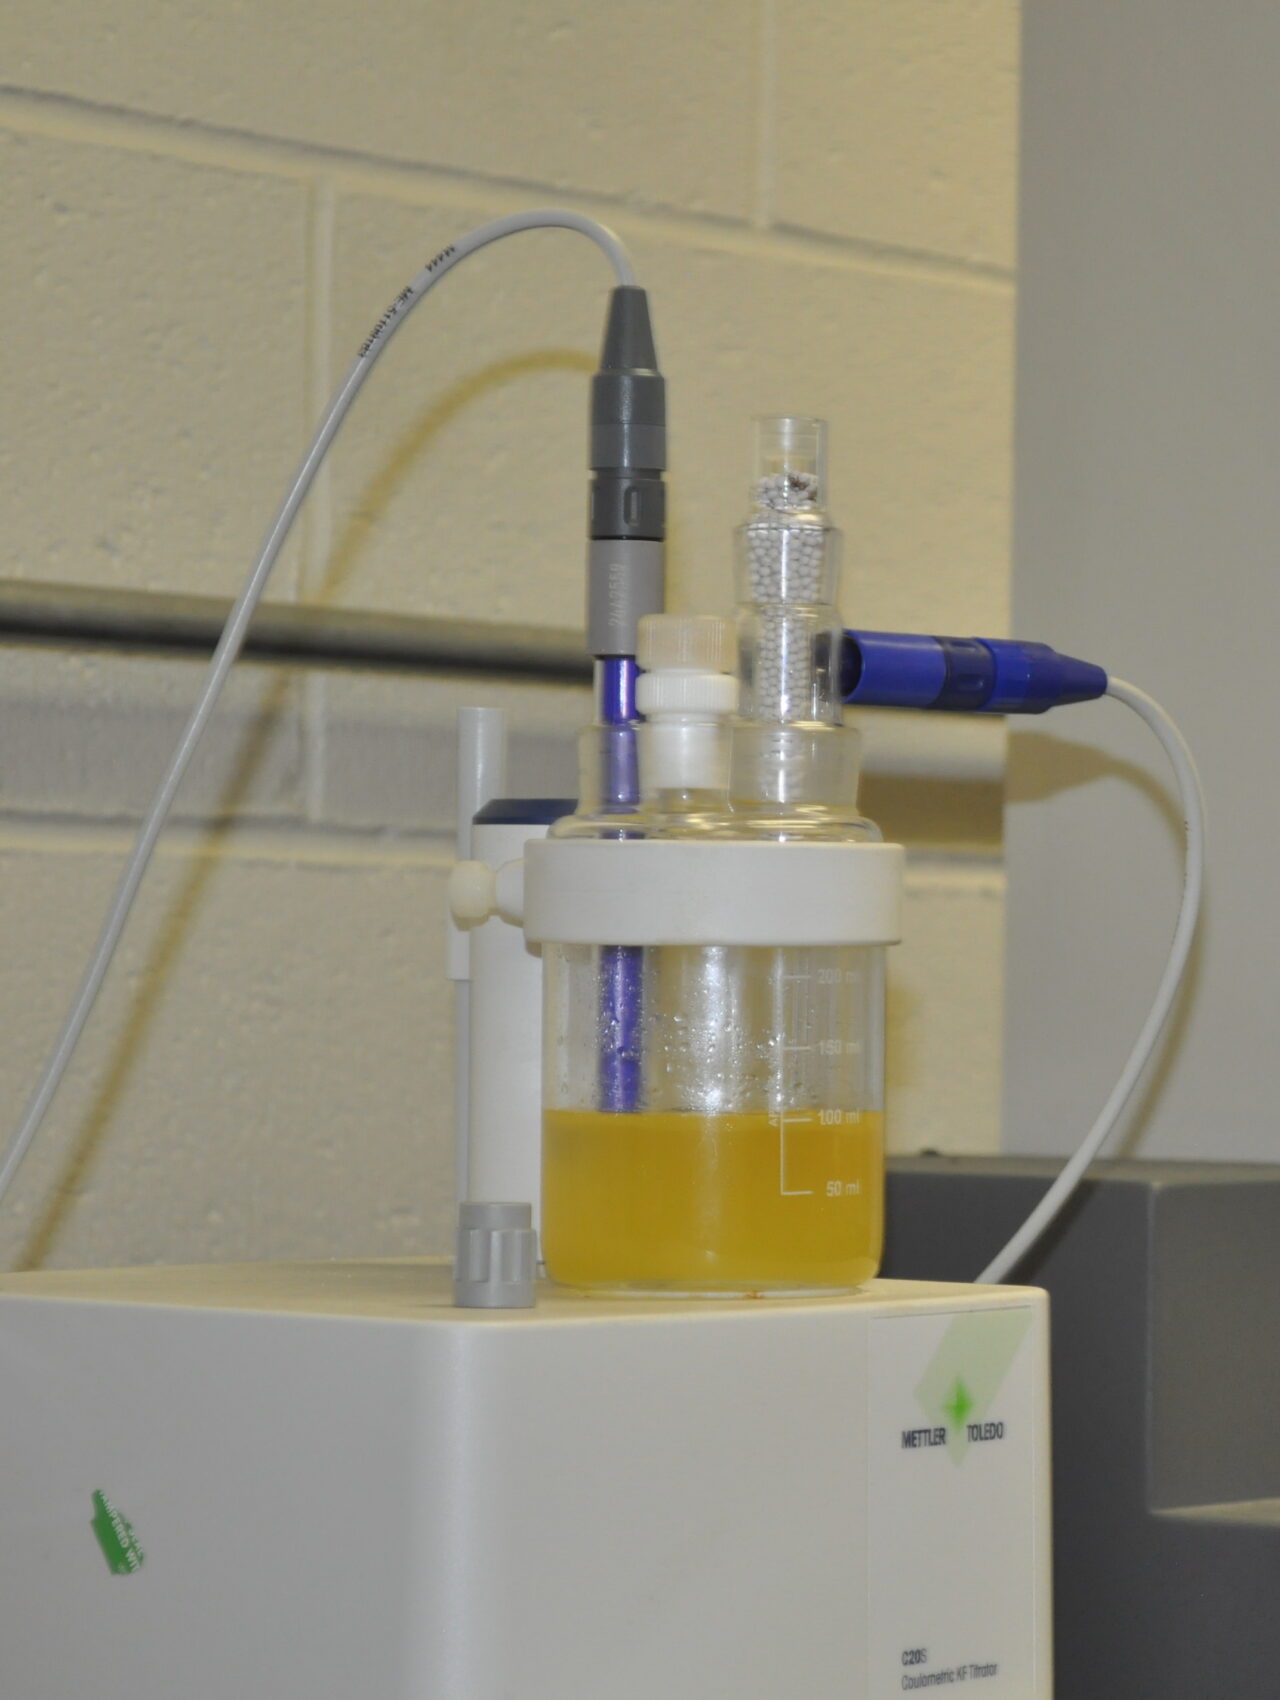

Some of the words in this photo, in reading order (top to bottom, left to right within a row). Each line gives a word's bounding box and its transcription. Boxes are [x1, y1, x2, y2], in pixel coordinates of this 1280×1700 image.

[818, 1039, 842, 1056] 150
[818, 1108, 842, 1126] 100
[845, 1107, 861, 1124] ml
[826, 1180, 842, 1198] 50
[845, 1178, 861, 1196] ml
[902, 1427, 946, 1449] METTLER
[966, 1421, 1004, 1443] TOLEDO
[901, 1648, 928, 1667] C20S
[901, 1669, 955, 1691] Coulometric
[956, 1664, 968, 1682] KF
[969, 1662, 998, 1680] Titrator
